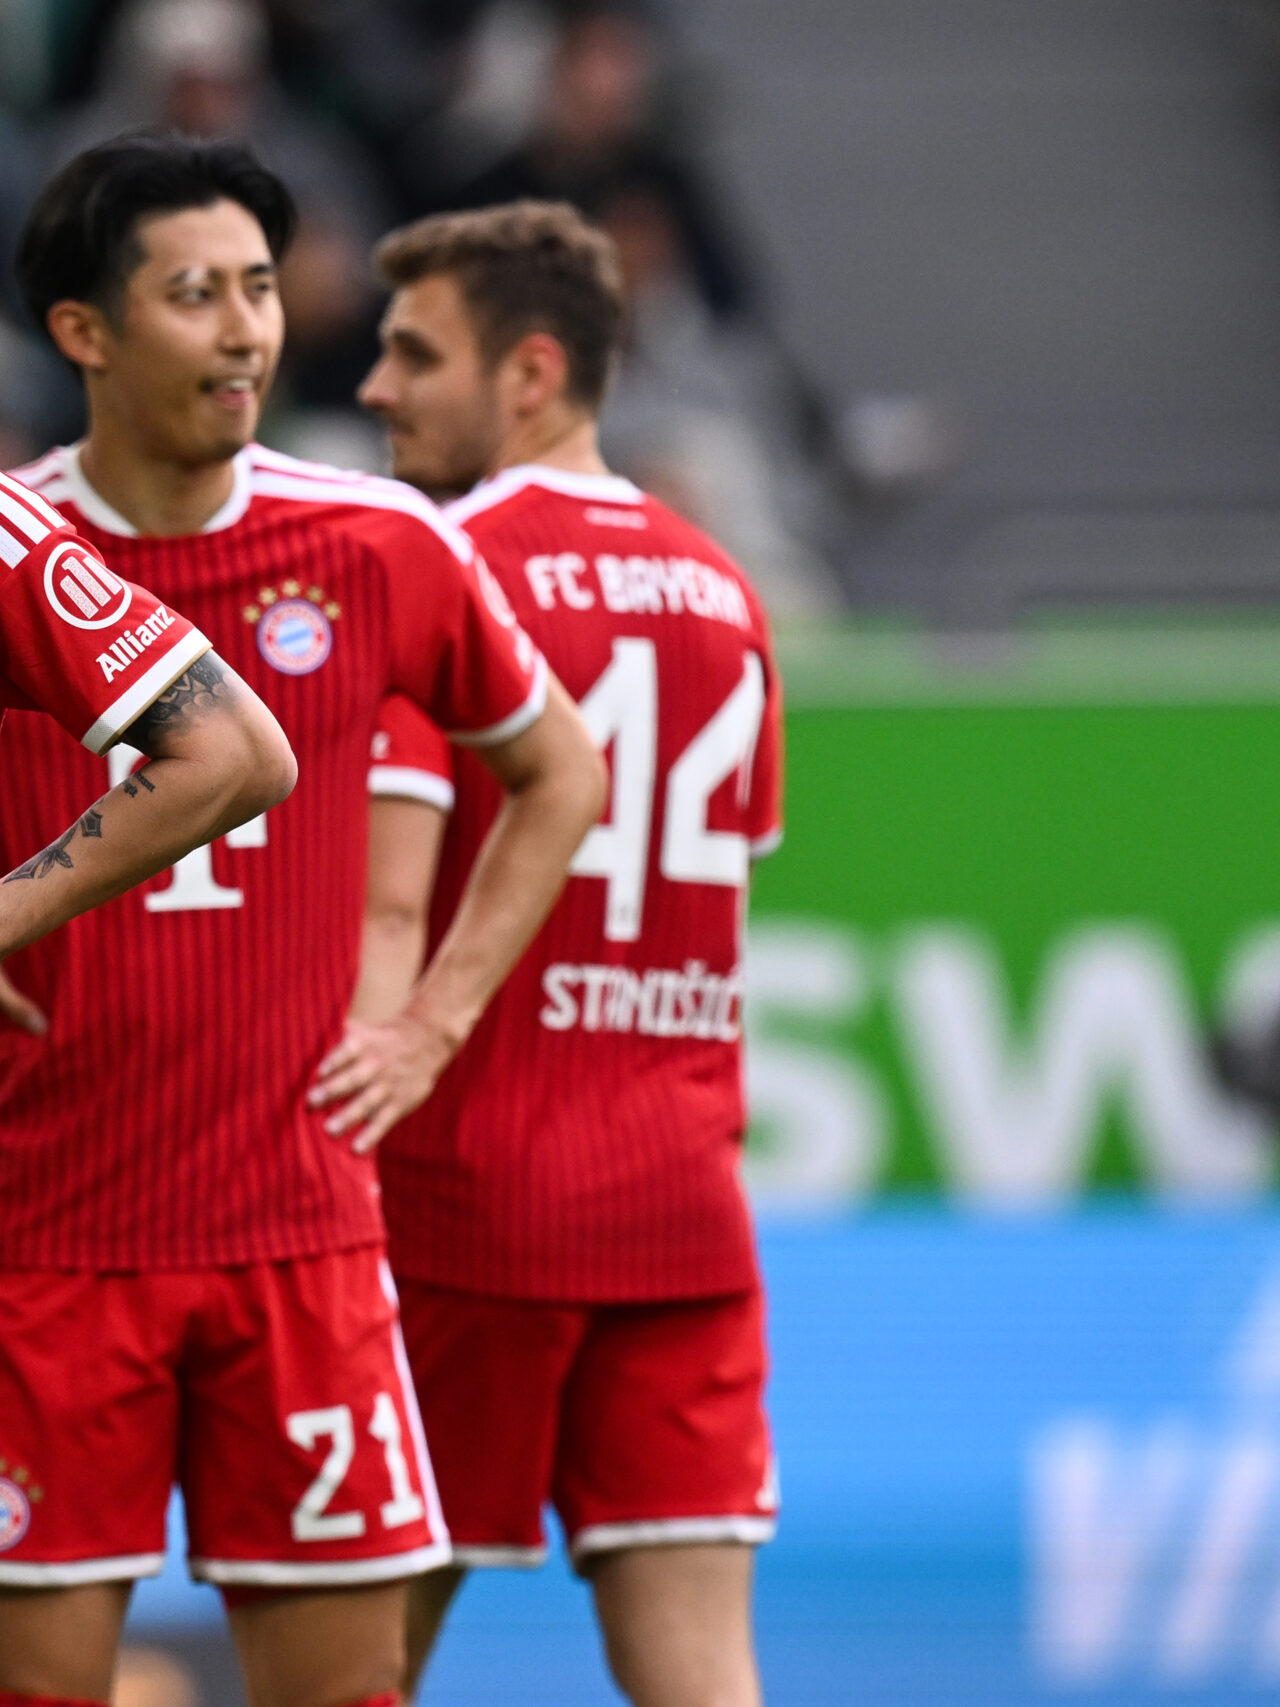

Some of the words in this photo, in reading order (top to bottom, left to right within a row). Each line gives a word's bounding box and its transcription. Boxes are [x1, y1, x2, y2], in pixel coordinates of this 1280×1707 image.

[524, 552, 595, 612] FC
[595, 554, 753, 632] BAYERN
[96, 605, 176, 684] Allianz
[286, 1393, 424, 1542] 21
